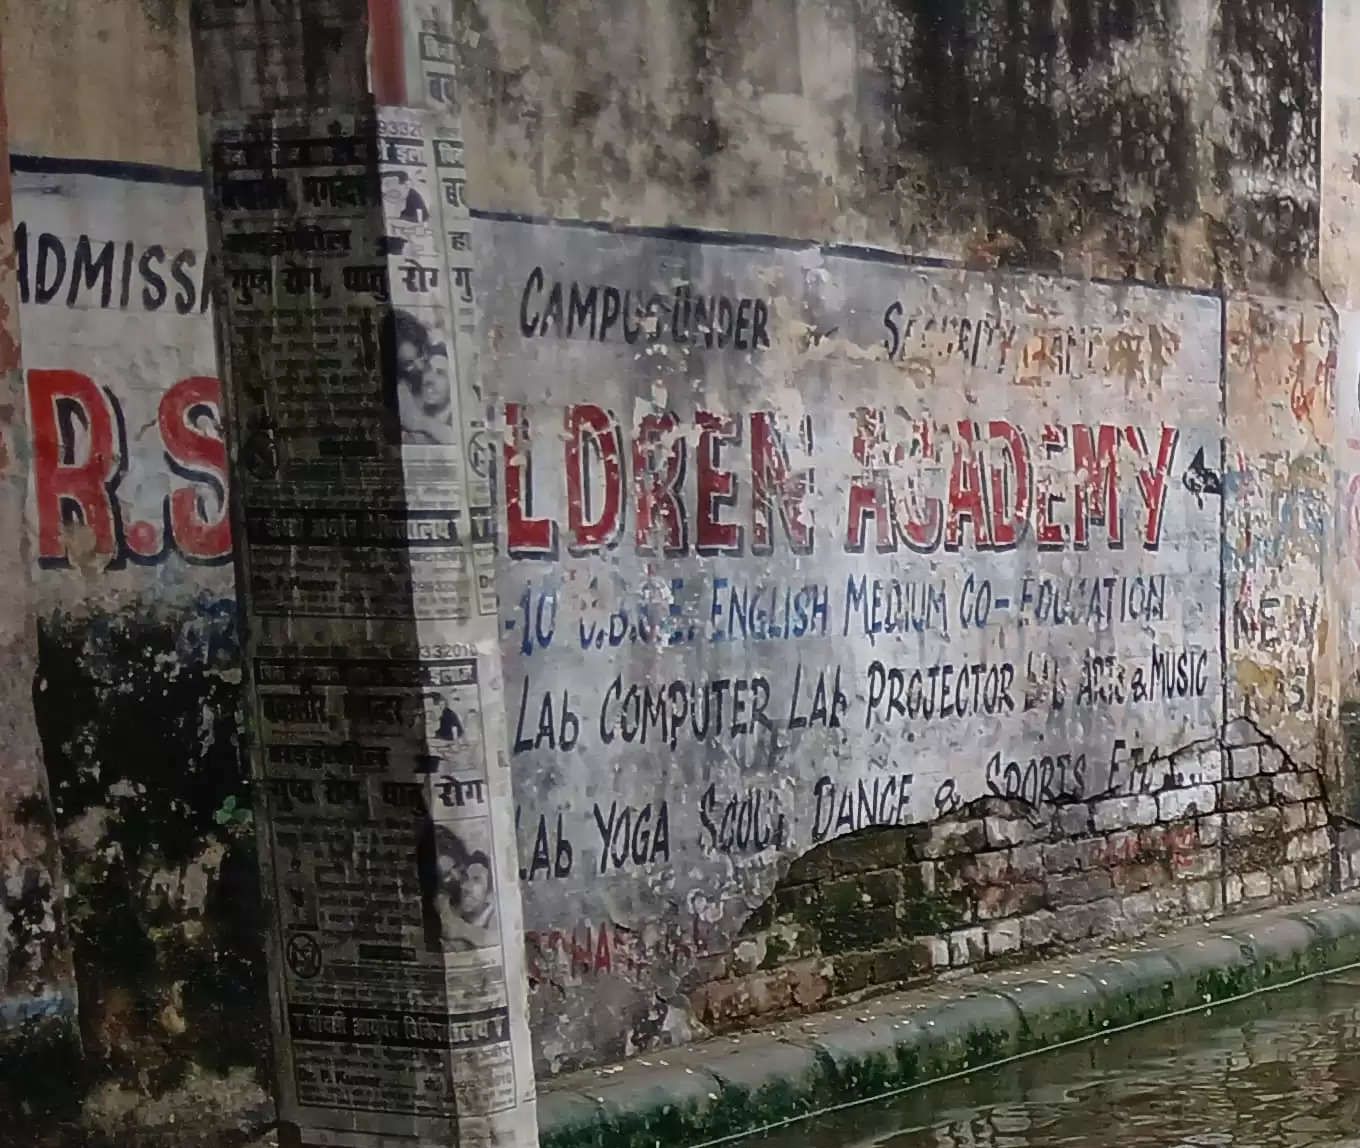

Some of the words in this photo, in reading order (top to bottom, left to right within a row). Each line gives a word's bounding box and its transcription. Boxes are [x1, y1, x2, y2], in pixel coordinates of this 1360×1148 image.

[13, 221, 210, 314] ADMISS
[843, 405, 1180, 554] ACADEMY
[709, 573, 829, 643] ENGLISH
[599, 674, 772, 750] COMPUTER
[866, 658, 1016, 730] PROJECTOR
[1149, 643, 1209, 702] MUSIC
[594, 800, 671, 874] YOGA
[813, 772, 913, 842] DANCE
